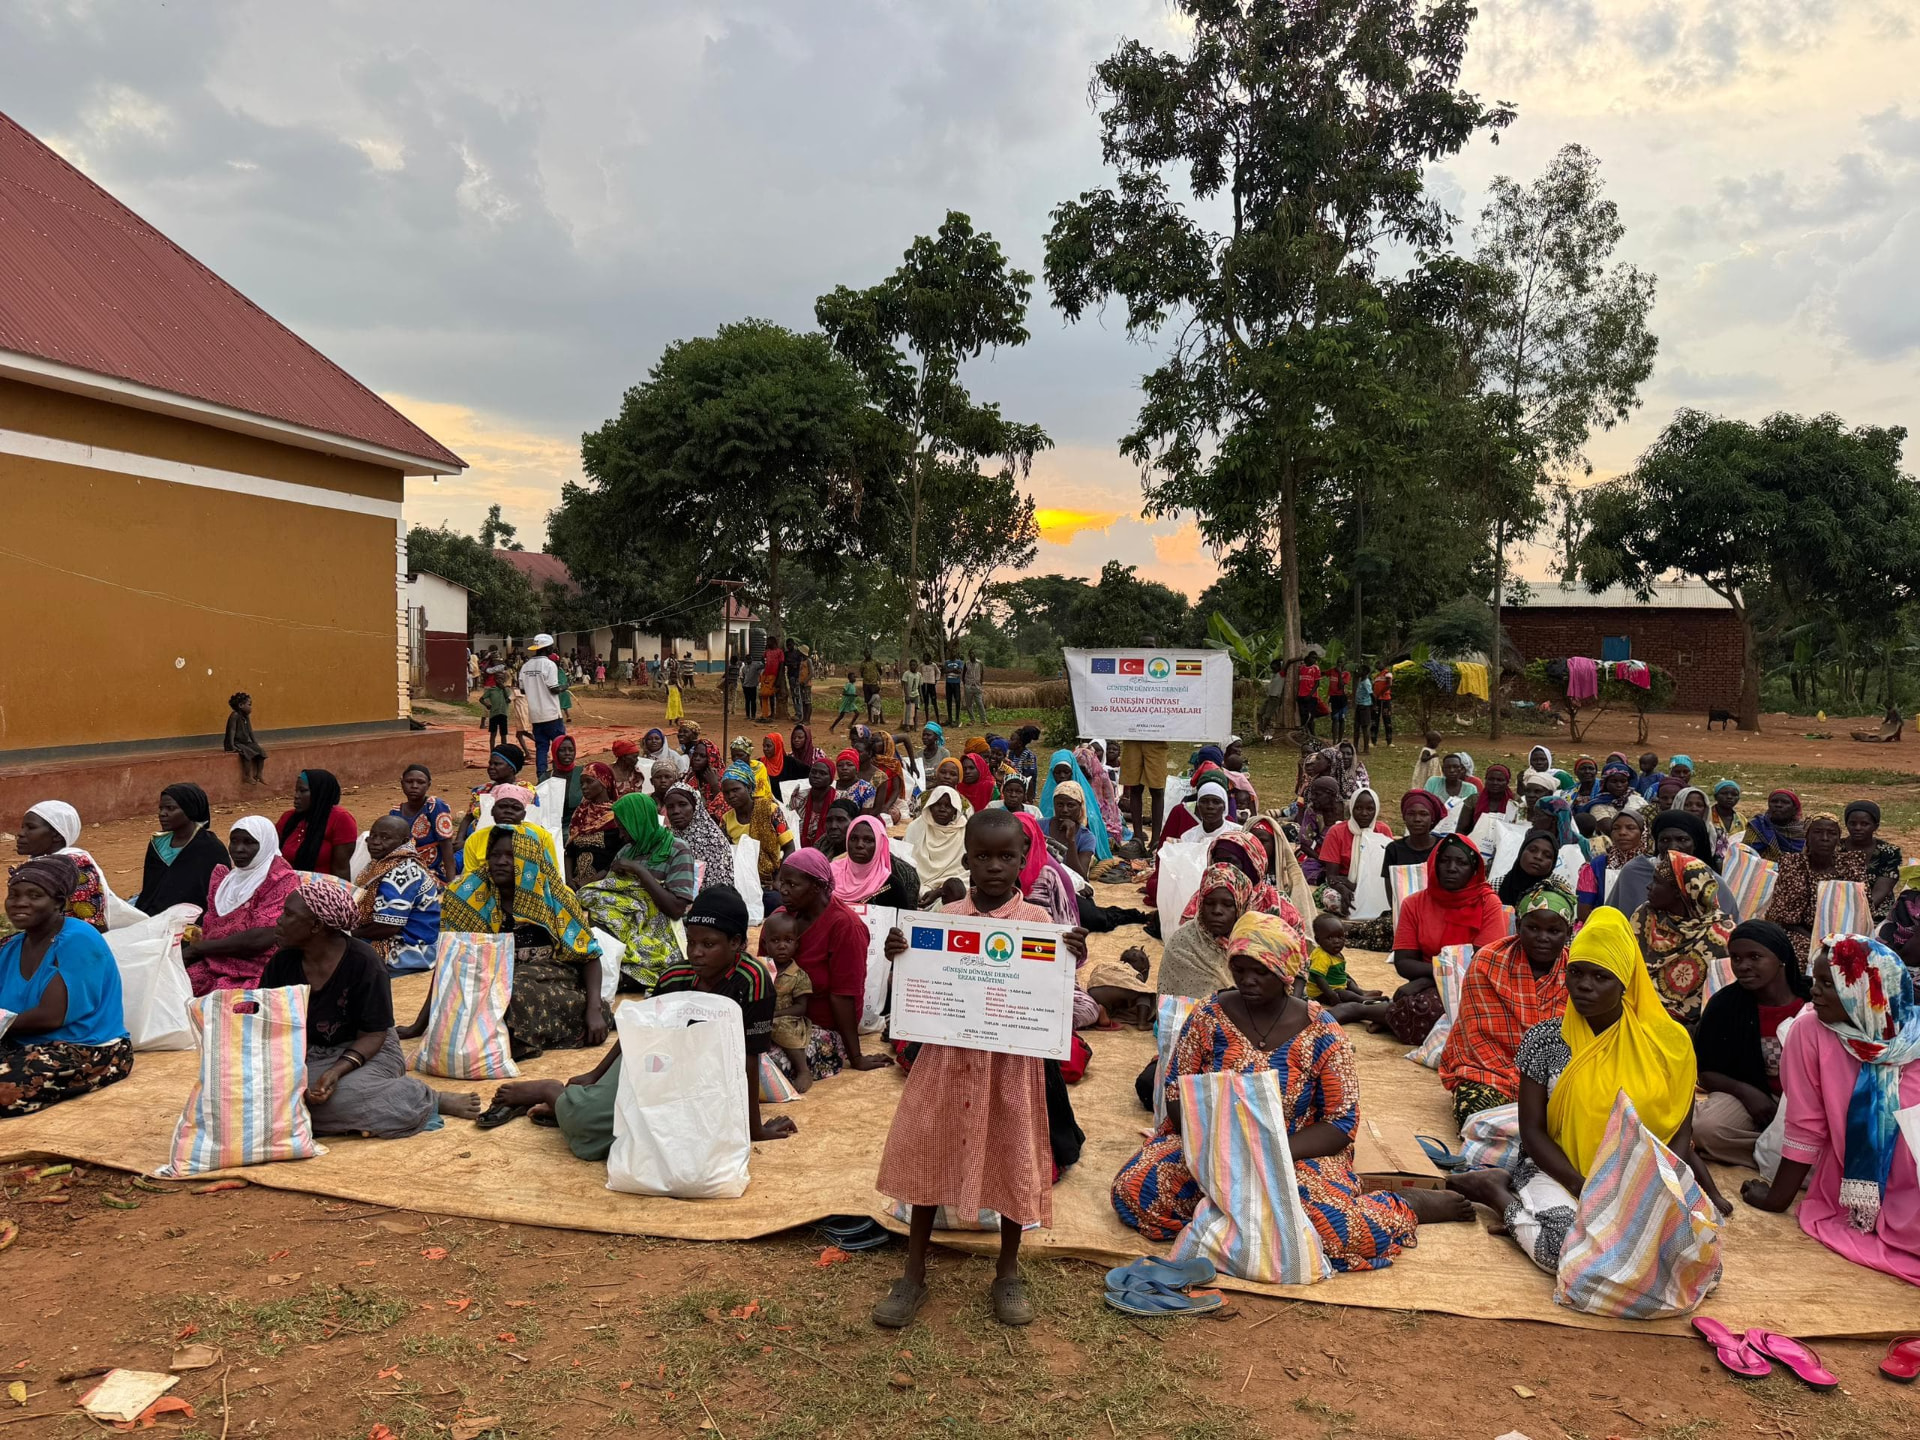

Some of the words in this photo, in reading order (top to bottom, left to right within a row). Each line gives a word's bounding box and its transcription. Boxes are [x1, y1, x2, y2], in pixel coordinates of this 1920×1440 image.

[1146, 697, 1179, 705] DÜNYASI
[1150, 706, 1201, 714] ÇALIŞMALARI
[969, 968, 993, 977] DÜNYASI
[995, 971, 1019, 979] DERNEĞİ
